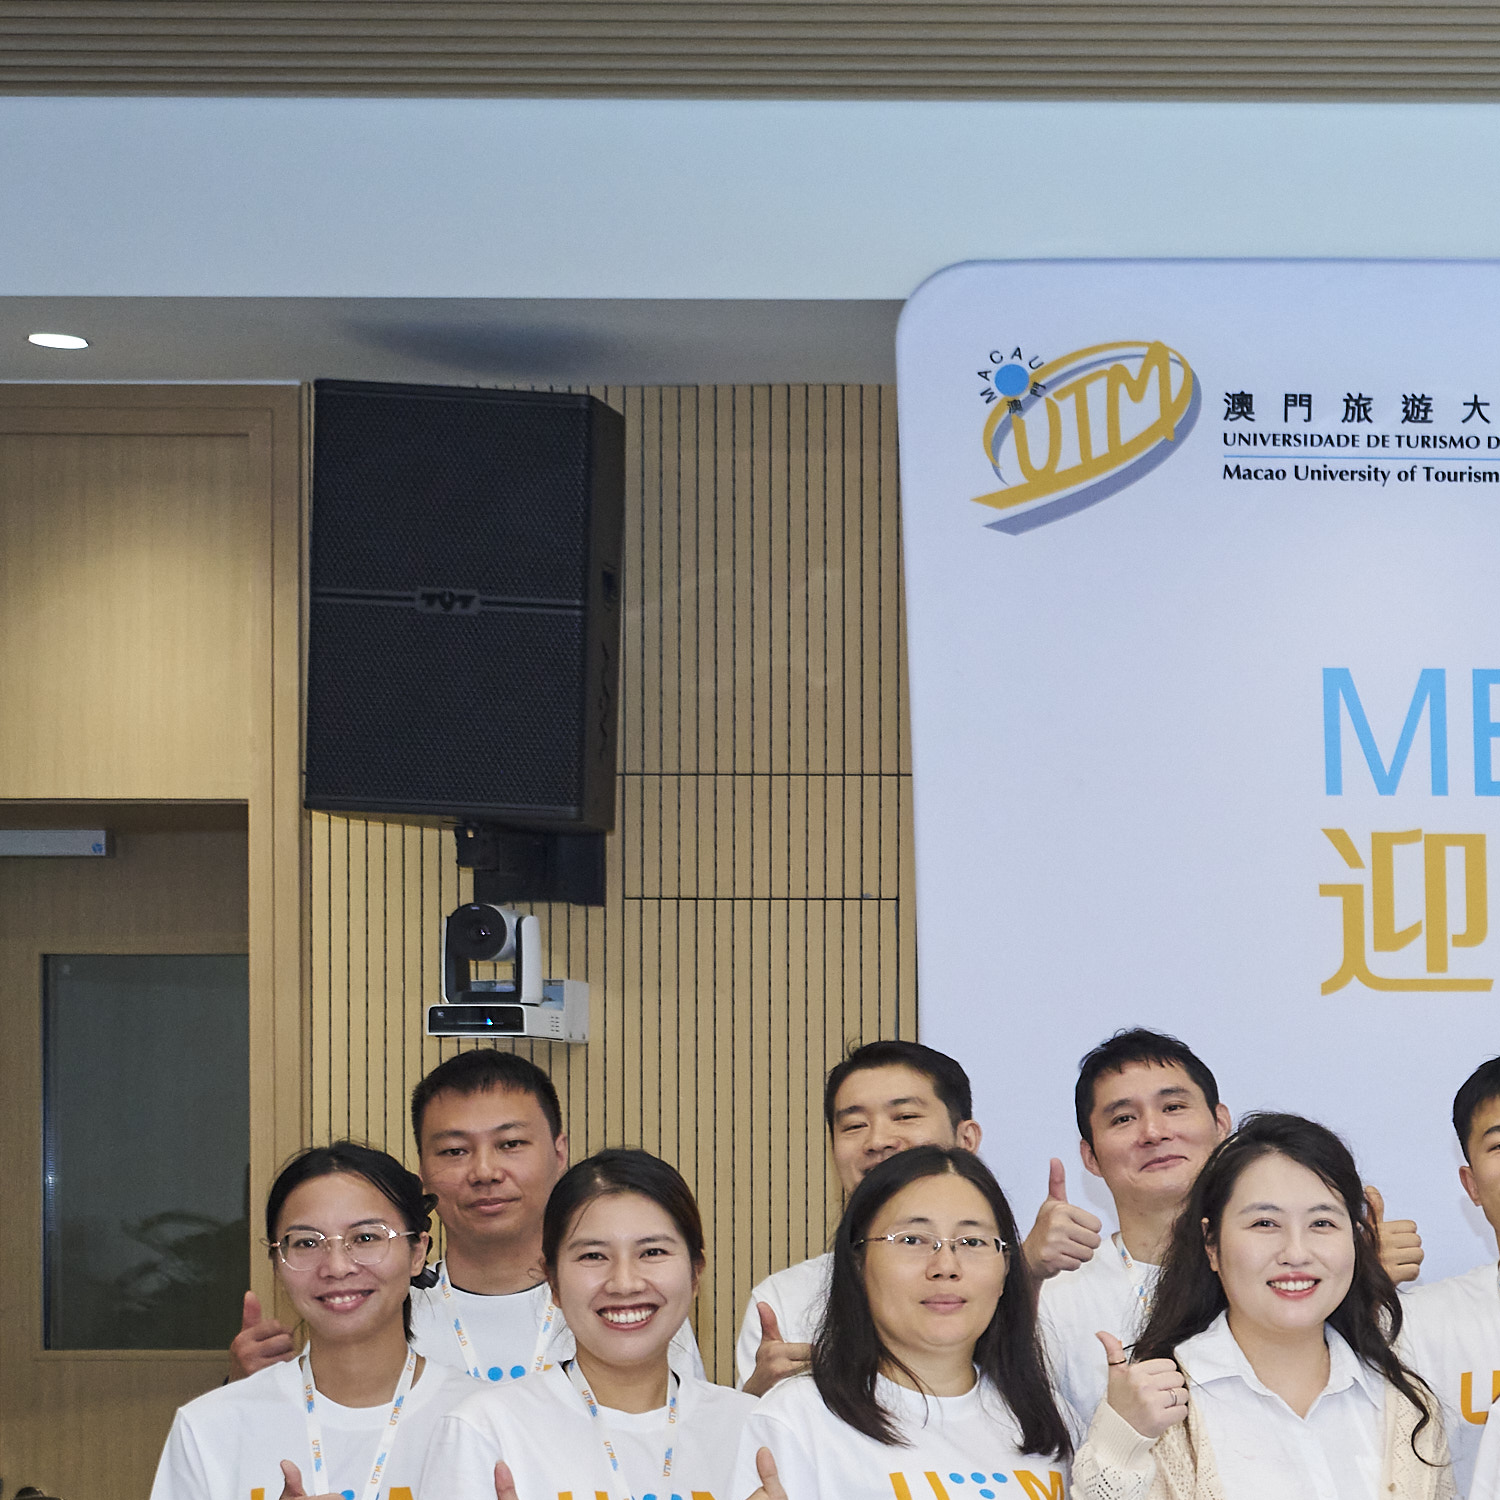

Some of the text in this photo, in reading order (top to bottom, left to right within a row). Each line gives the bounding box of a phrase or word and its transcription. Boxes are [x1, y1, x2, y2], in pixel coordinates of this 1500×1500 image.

[978, 347, 1044, 404] MACAU
[1224, 433, 1359, 447] UNIVERSIDADE
[1367, 435, 1389, 448] DE
[1395, 435, 1480, 449] TURISMO
[1223, 464, 1499, 486] Macao University of Tourism
